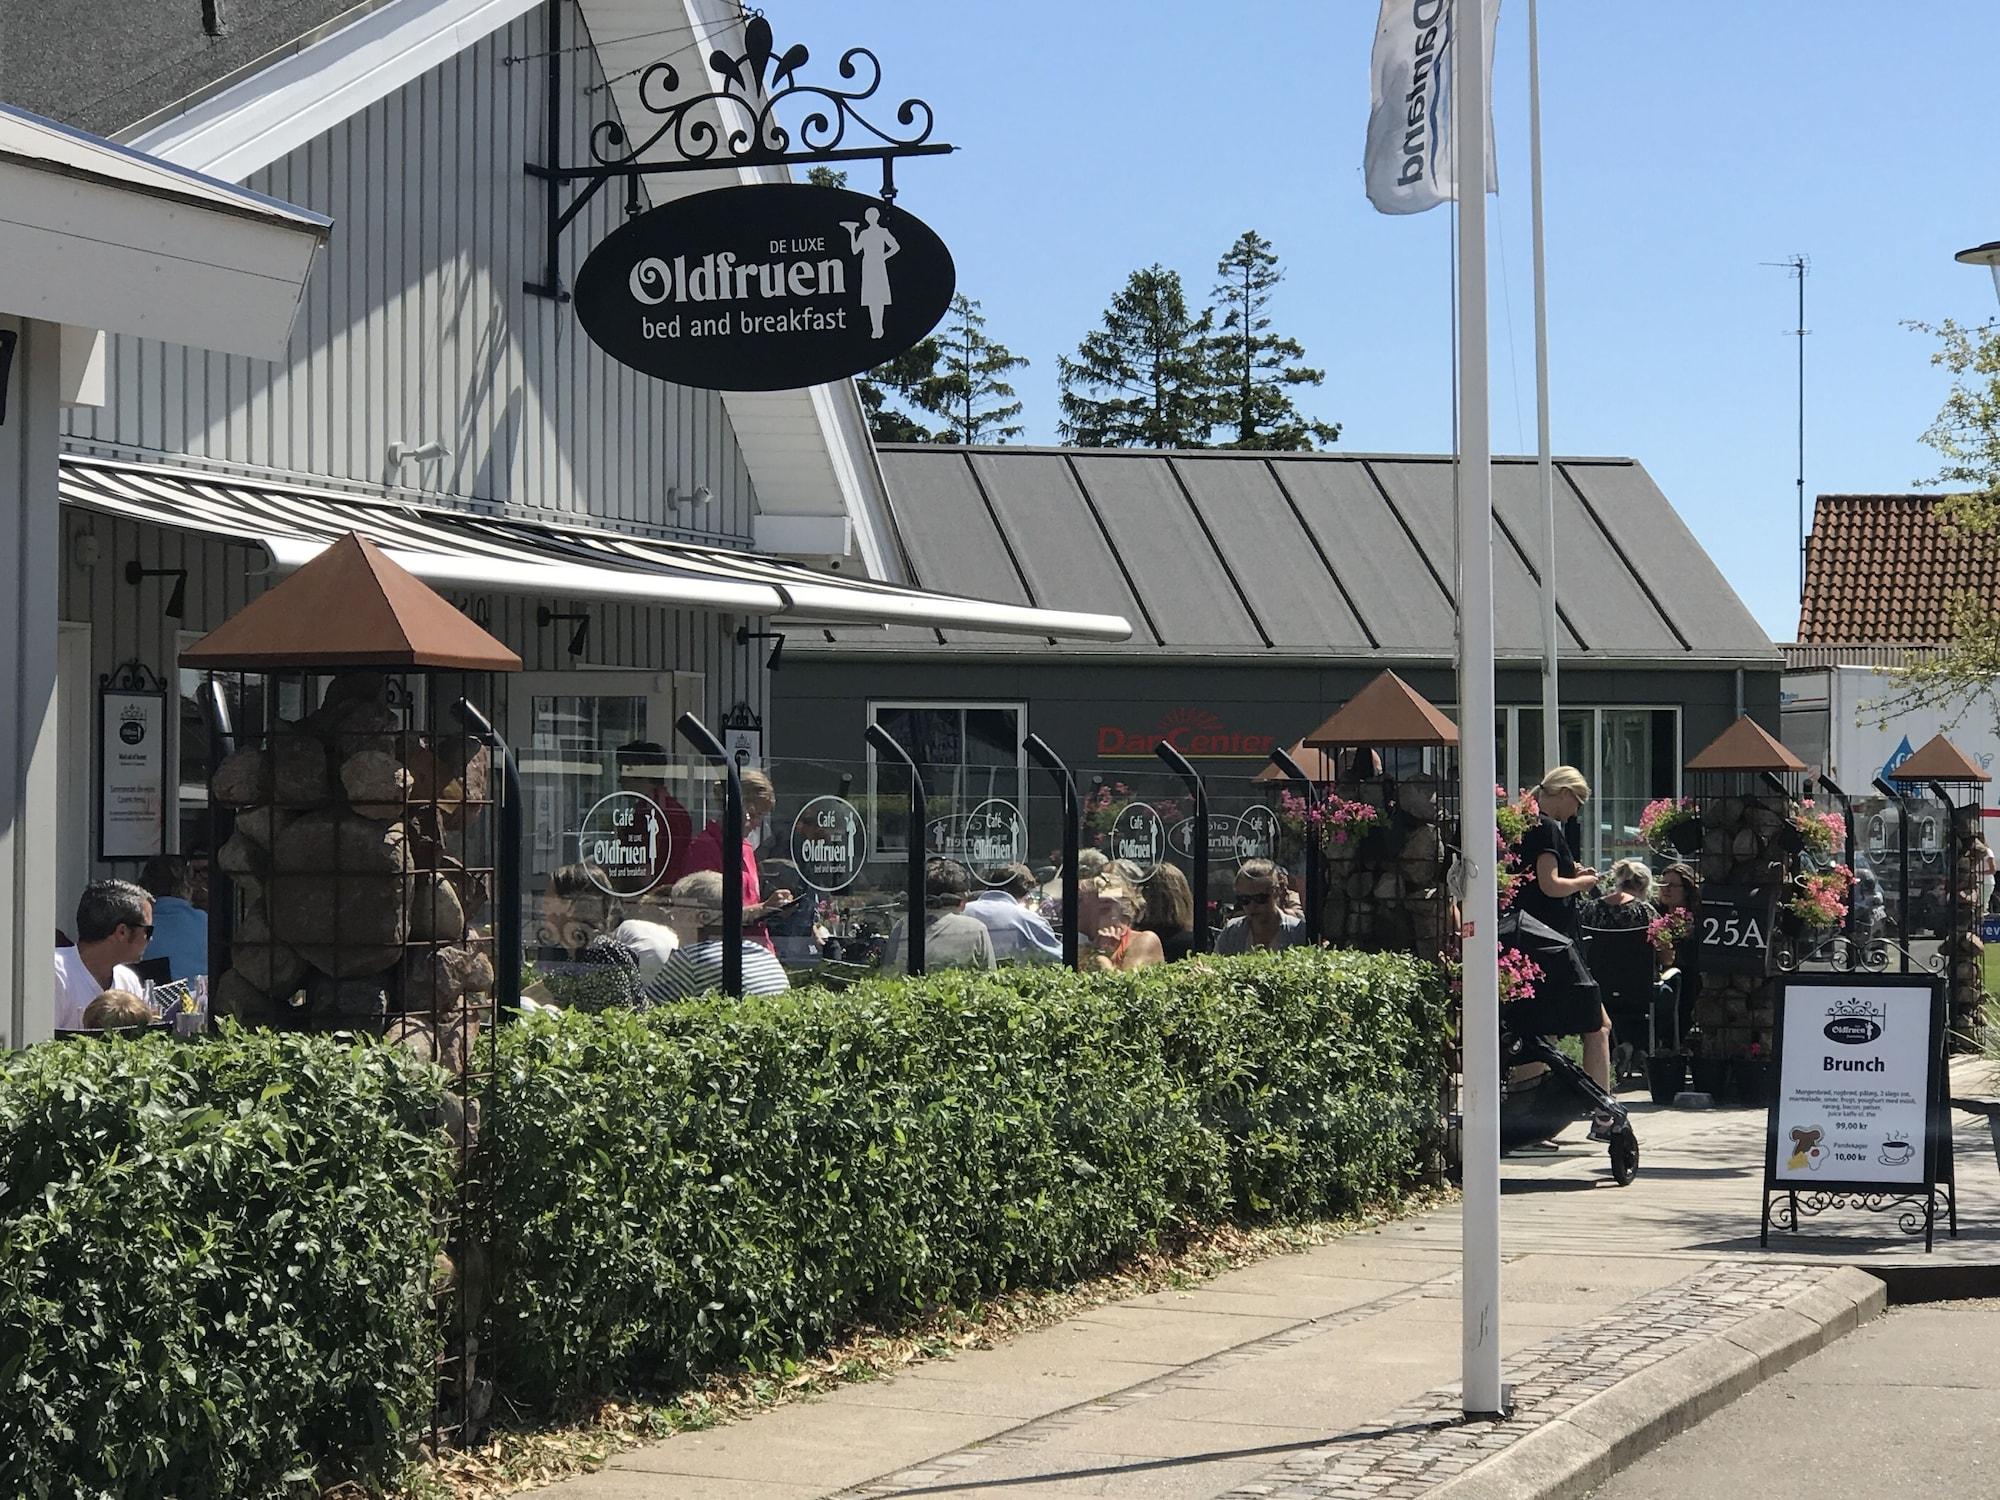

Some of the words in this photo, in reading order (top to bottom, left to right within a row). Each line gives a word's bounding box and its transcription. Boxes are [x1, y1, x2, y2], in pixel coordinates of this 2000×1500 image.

[769, 239, 788, 254] DE
[791, 236, 826, 253] LUXE
[628, 251, 846, 306] Oldfruen
[642, 315, 681, 341] bed
[690, 311, 731, 338] and
[741, 306, 847, 335] breakfast
[612, 807, 635, 827] Café
[817, 810, 836, 828] Café
[594, 839, 647, 865] Oldfruen
[801, 838, 846, 862] Oldfruen
[1702, 917, 1768, 949] 25A
[1823, 1056, 1885, 1073] Brunch
[1835, 1122, 1858, 1130] 99,00
[1859, 1122, 1868, 1130] kr
[1835, 1153, 1857, 1161] 10,00
[1857, 1153, 1867, 1161] kr
